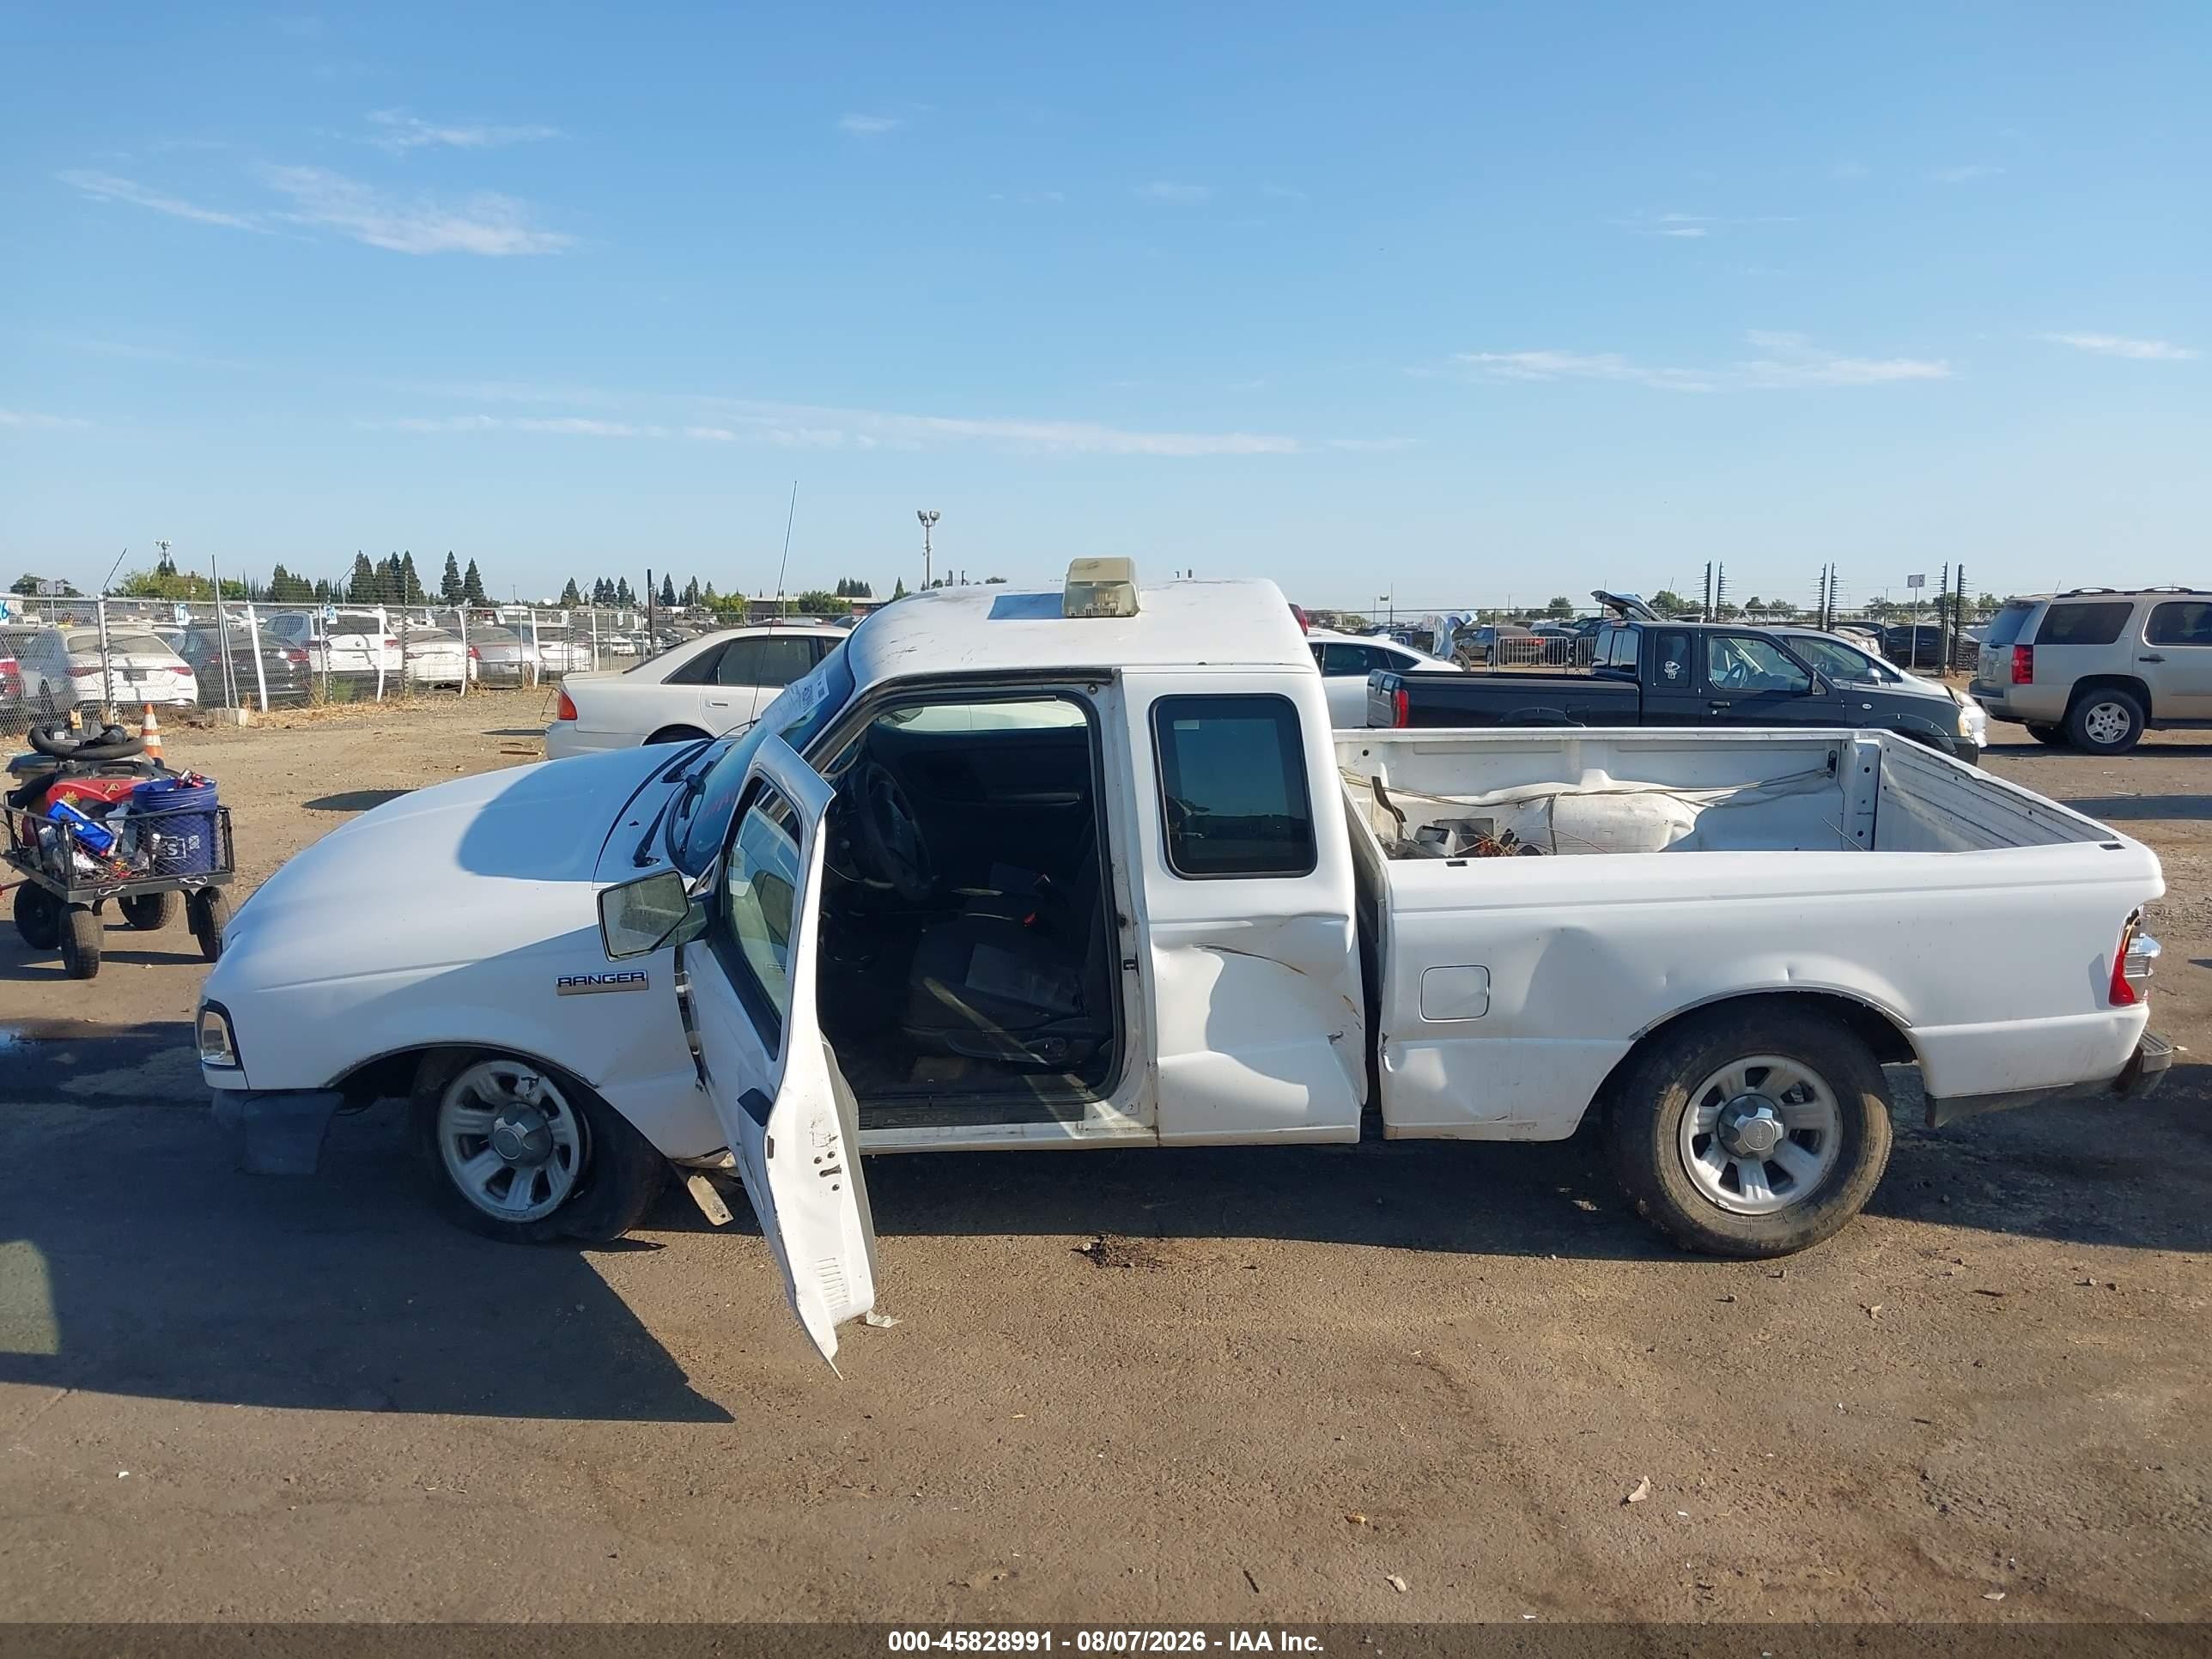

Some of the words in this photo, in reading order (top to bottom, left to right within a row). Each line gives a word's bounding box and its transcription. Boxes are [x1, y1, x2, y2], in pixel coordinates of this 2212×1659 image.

[39, 581, 47, 594] G
[55, 580, 62, 594] F
[557, 971, 646, 988] RANGER
